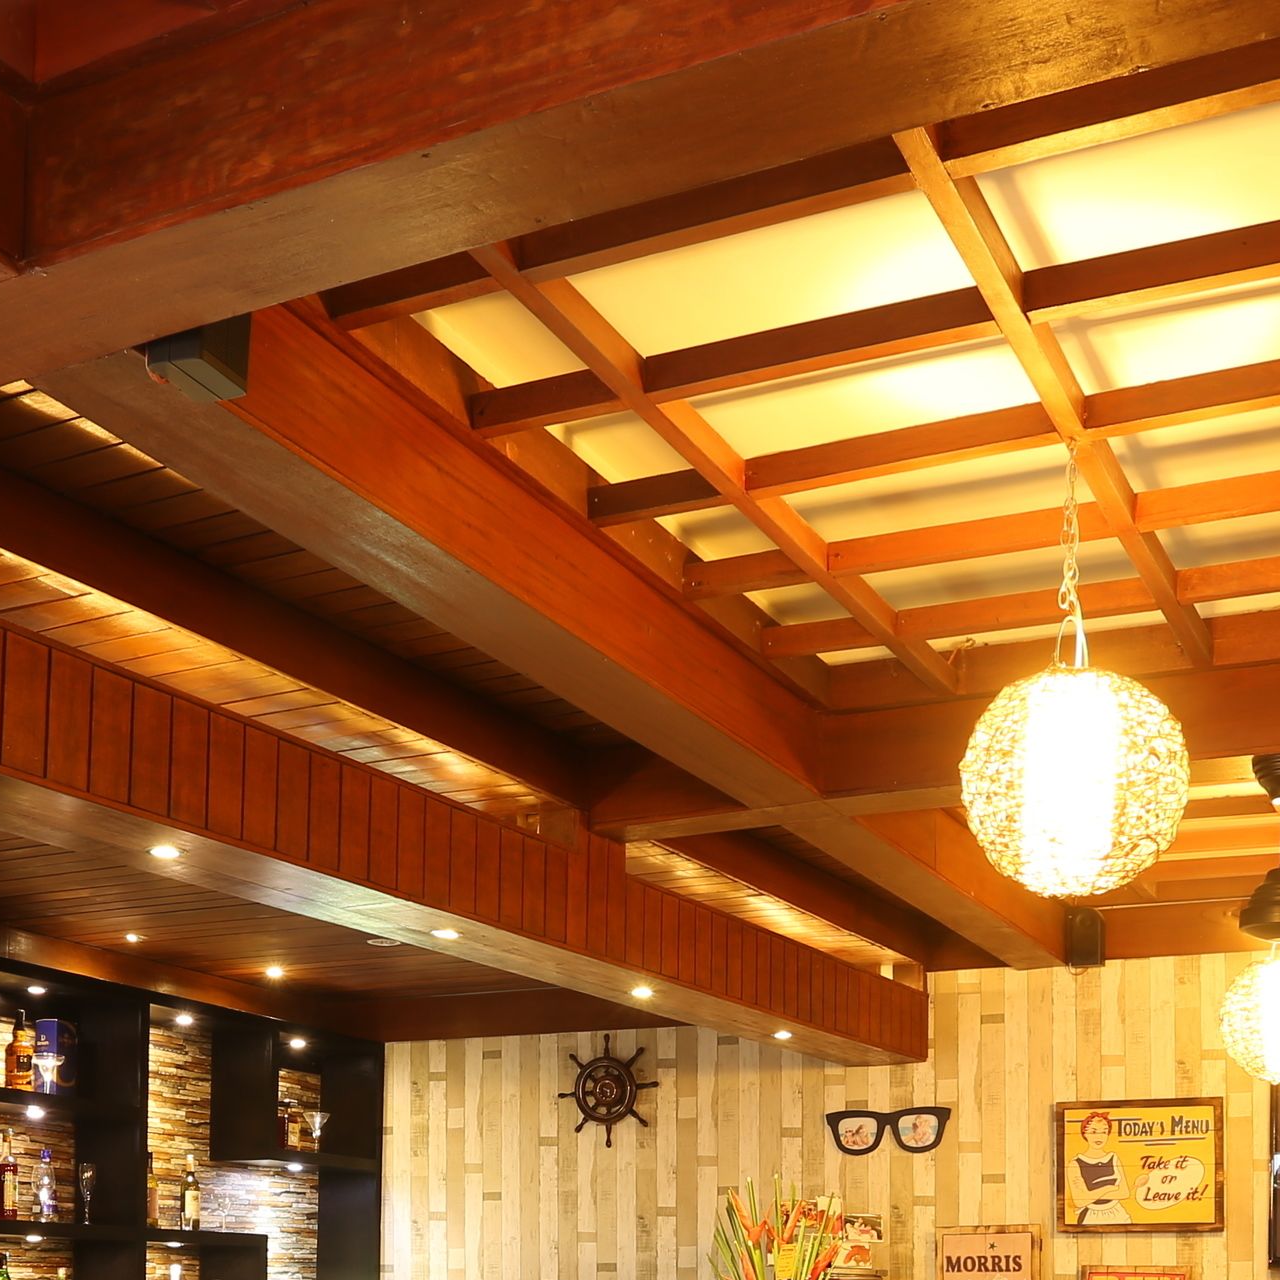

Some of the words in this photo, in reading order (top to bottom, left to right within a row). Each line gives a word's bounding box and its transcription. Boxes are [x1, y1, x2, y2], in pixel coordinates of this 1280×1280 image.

[1140, 1155, 1170, 1170] Take
[1175, 1155, 1189, 1170] it
[1162, 1175, 1177, 1185] or
[1143, 1187, 1181, 1201] Leave
[1185, 1184, 1209, 1201] it!
[945, 1255, 1022, 1273] MORRIS
